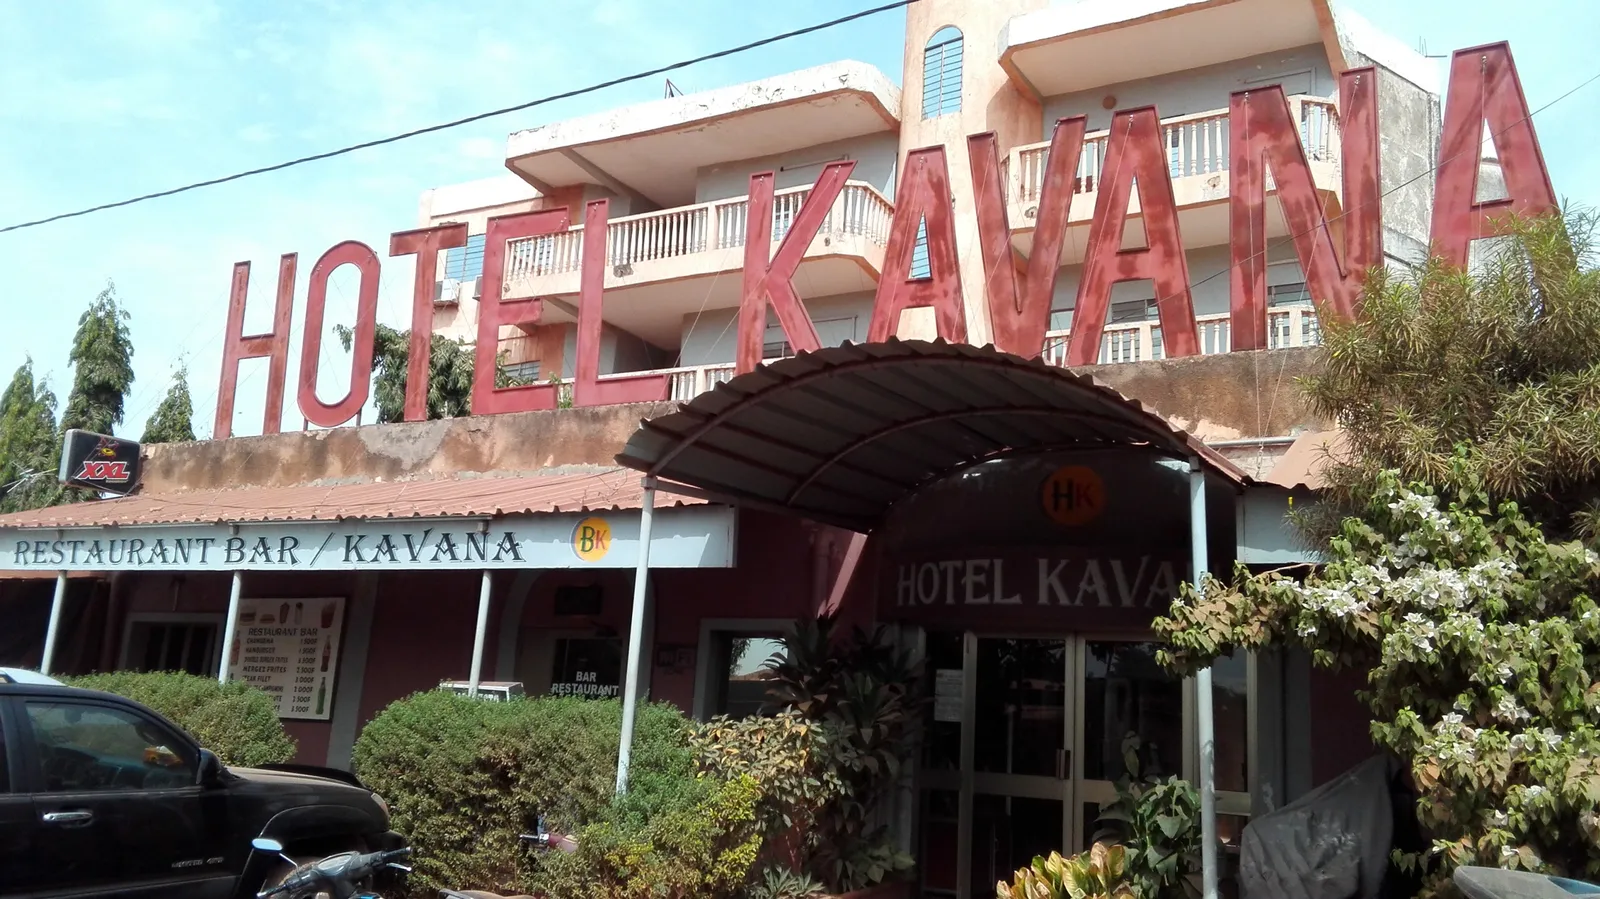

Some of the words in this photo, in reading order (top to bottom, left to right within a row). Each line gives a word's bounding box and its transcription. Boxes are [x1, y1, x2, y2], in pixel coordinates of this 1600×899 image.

[213, 197, 670, 440] HOTEL
[735, 40, 1573, 374] KAVANA
[74, 461, 131, 480] XXL
[1051, 477, 1094, 512] HK
[13, 537, 215, 565] RESTAURANT
[223, 536, 301, 565] BAR
[342, 527, 527, 564] KAVANA
[580, 525, 608, 552] BK
[896, 557, 1023, 608] HOTEL
[1037, 554, 1193, 608] KAVA
[248, 627, 298, 636] RESTAURANT
[300, 628, 318, 636] BAR
[551, 683, 619, 696] RESTAURANT
[575, 671, 597, 682] BAR
